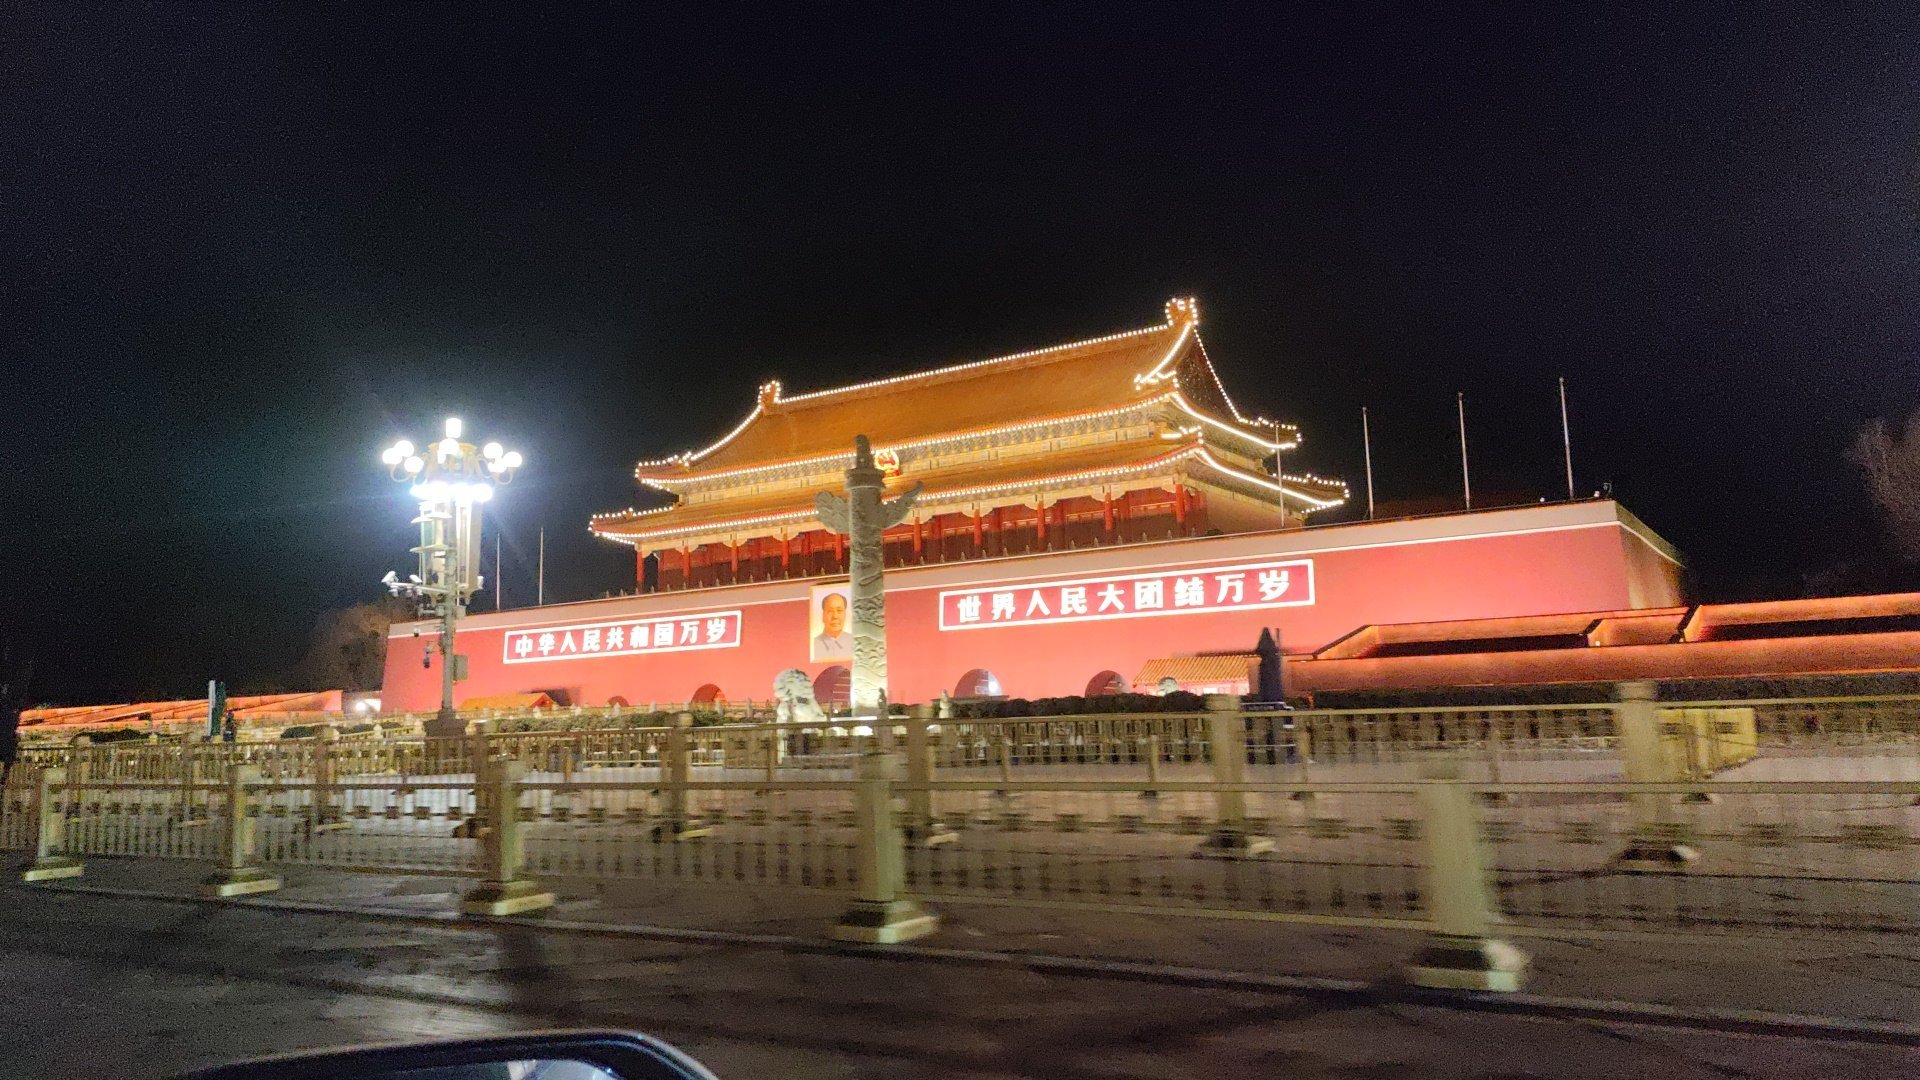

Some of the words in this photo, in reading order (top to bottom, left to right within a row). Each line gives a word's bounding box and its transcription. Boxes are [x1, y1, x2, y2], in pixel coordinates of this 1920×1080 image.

[957, 570, 1290, 623] 世界人民大团结万岁
[515, 618, 726, 657] 中华人民共和国万岁
